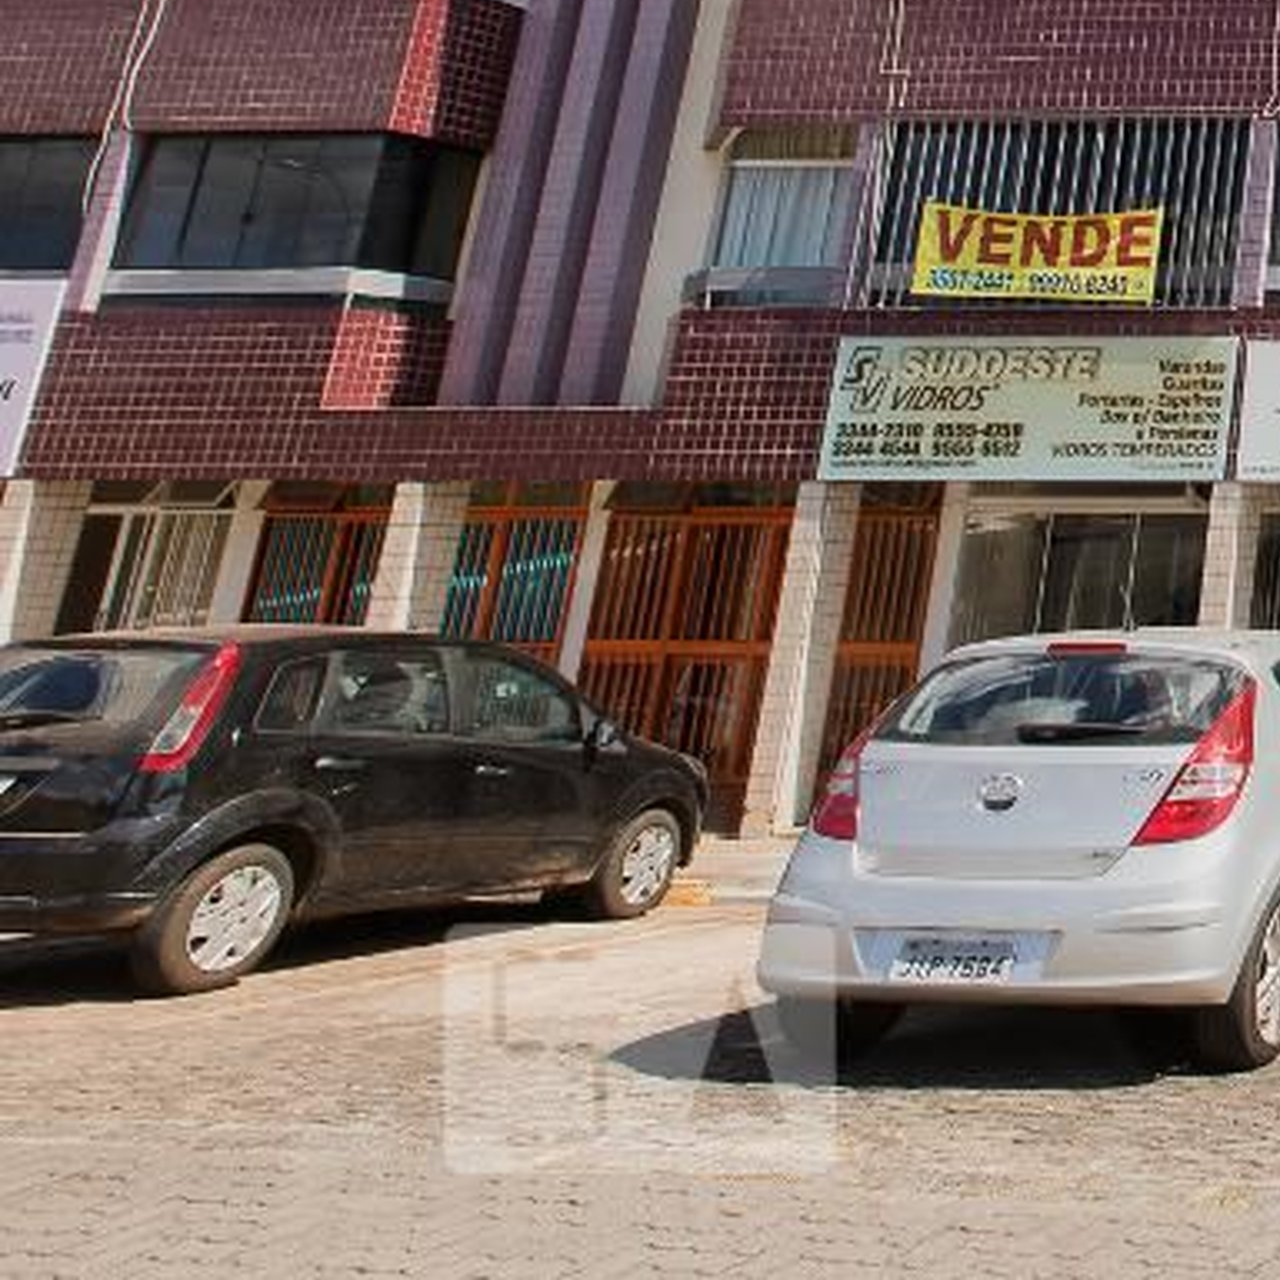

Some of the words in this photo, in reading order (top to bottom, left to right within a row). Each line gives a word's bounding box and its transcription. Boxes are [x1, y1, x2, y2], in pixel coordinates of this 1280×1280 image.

[933, 209, 1156, 268] VENDE
[902, 346, 1101, 382] SUDOESTE
[890, 384, 990, 411] VIDROS
